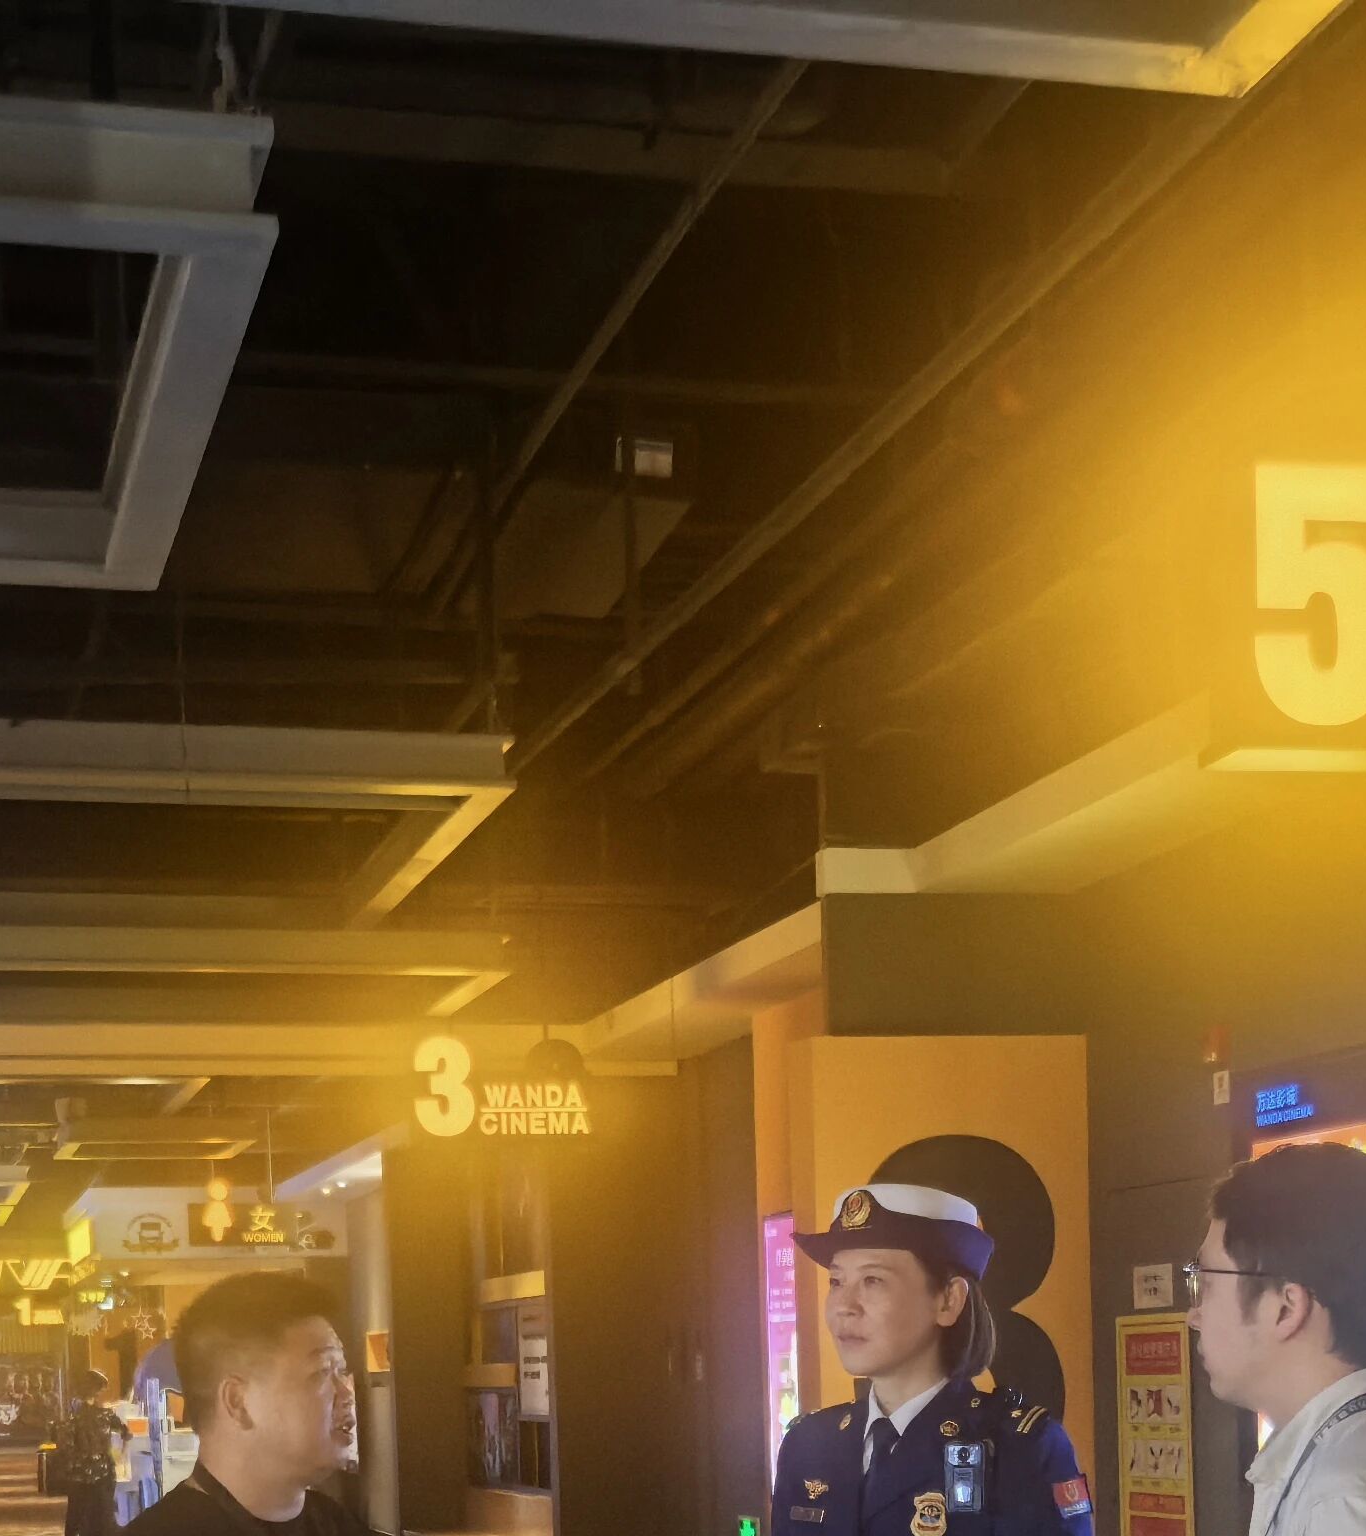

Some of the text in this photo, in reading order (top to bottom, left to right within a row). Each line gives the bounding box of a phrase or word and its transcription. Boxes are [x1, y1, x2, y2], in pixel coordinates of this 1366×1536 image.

[414, 1036, 475, 1136] 3
[483, 1083, 583, 1108] WANDA
[480, 1112, 590, 1136] CINEMA
[250, 1206, 275, 1231] 女
[243, 1232, 284, 1243] WOMEN
